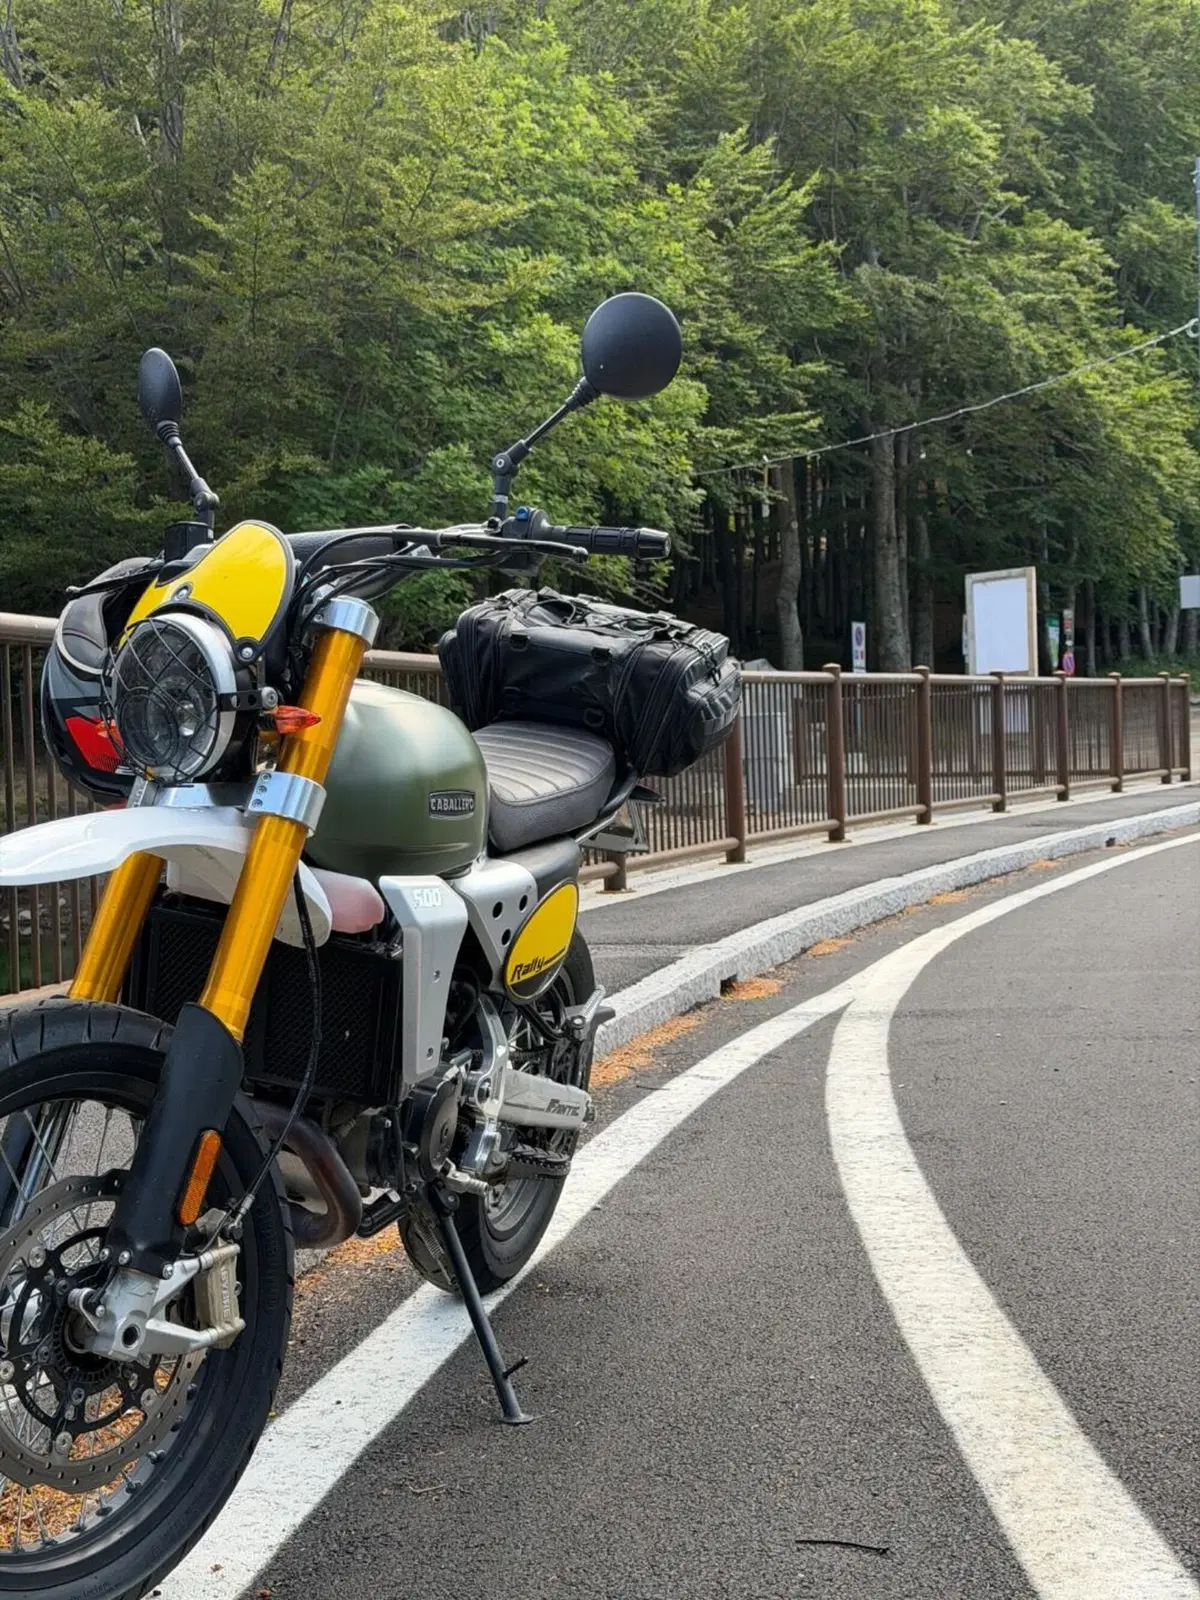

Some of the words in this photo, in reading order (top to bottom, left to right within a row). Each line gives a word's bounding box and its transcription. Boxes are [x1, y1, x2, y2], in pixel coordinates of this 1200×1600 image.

[430, 798, 474, 811] CABALLERO
[411, 888, 442, 909] 500
[510, 955, 548, 982] Rally
